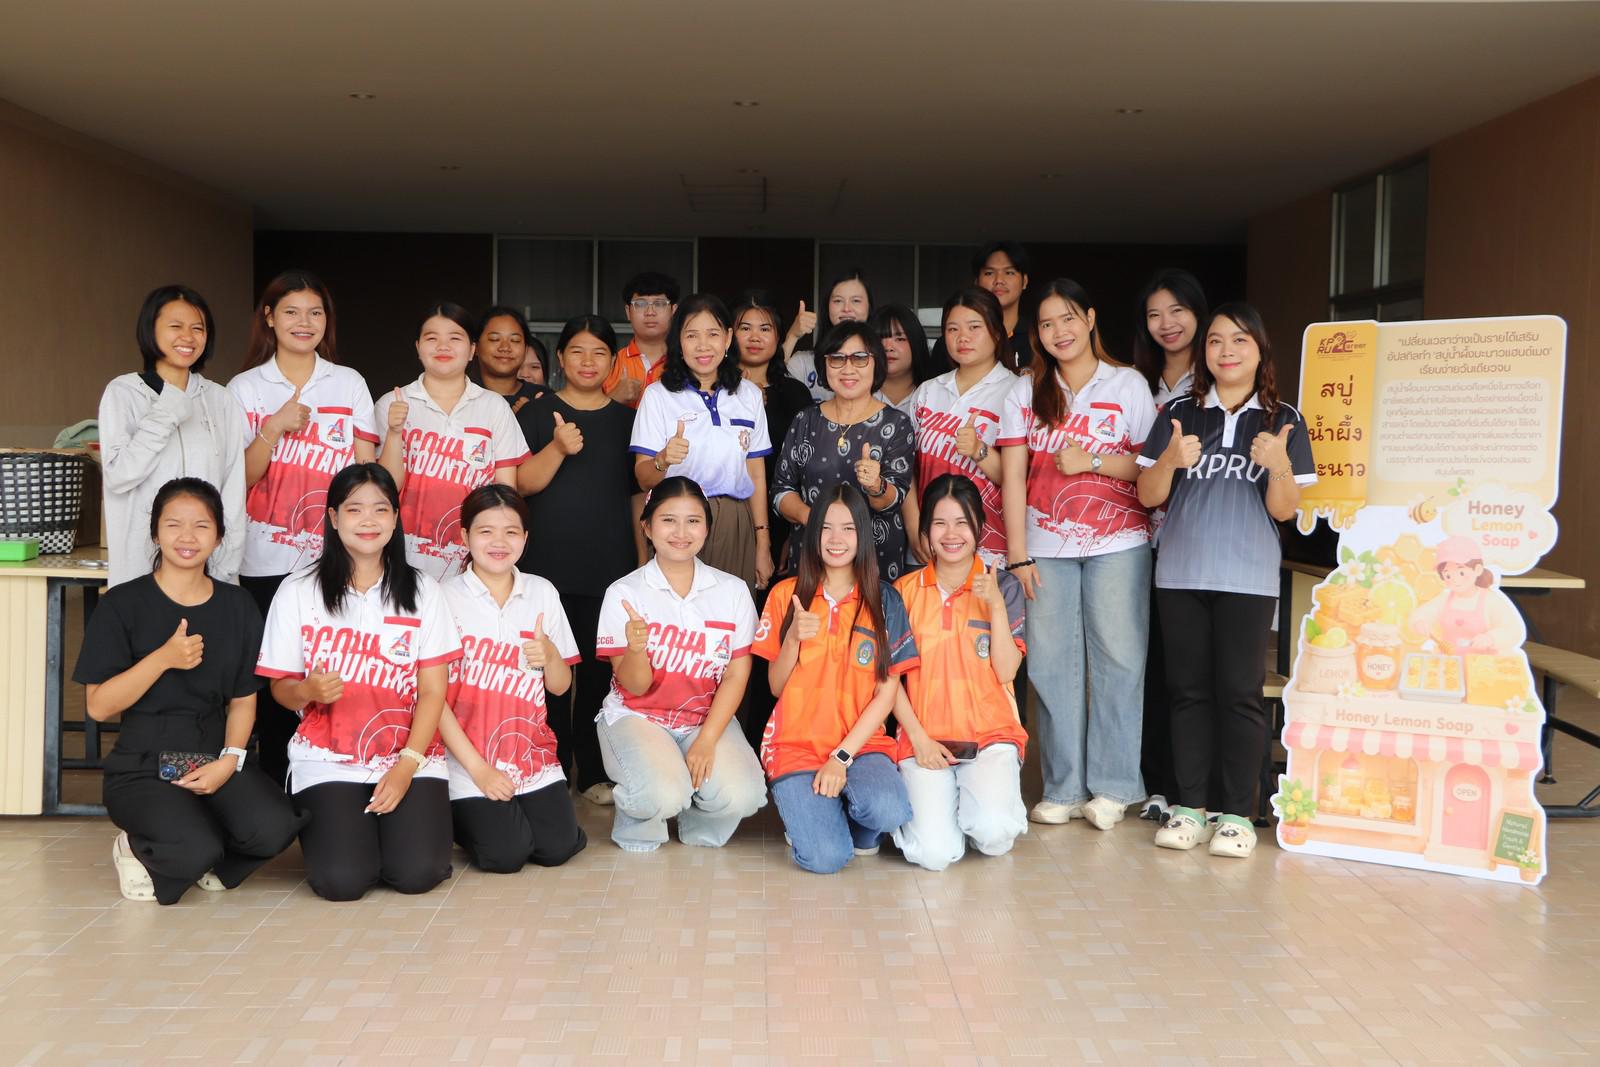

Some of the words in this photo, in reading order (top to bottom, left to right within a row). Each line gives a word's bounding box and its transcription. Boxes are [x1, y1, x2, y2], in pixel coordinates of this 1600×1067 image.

[1320, 374, 1354, 406] สบู่
[1308, 414, 1363, 441] น้ำผึ้ง
[1186, 453, 1265, 483] KPRU
[1316, 462, 1366, 477] ะนาว
[1468, 500, 1525, 519] Honey
[1471, 517, 1524, 532] Lemon
[1482, 534, 1520, 549] Soap
[1367, 663, 1392, 672] HONEY
[1336, 709, 1379, 726] Honey
[1384, 712, 1431, 729] Lemon
[1436, 717, 1474, 735] Soap
[1456, 787, 1478, 797] OPEN
